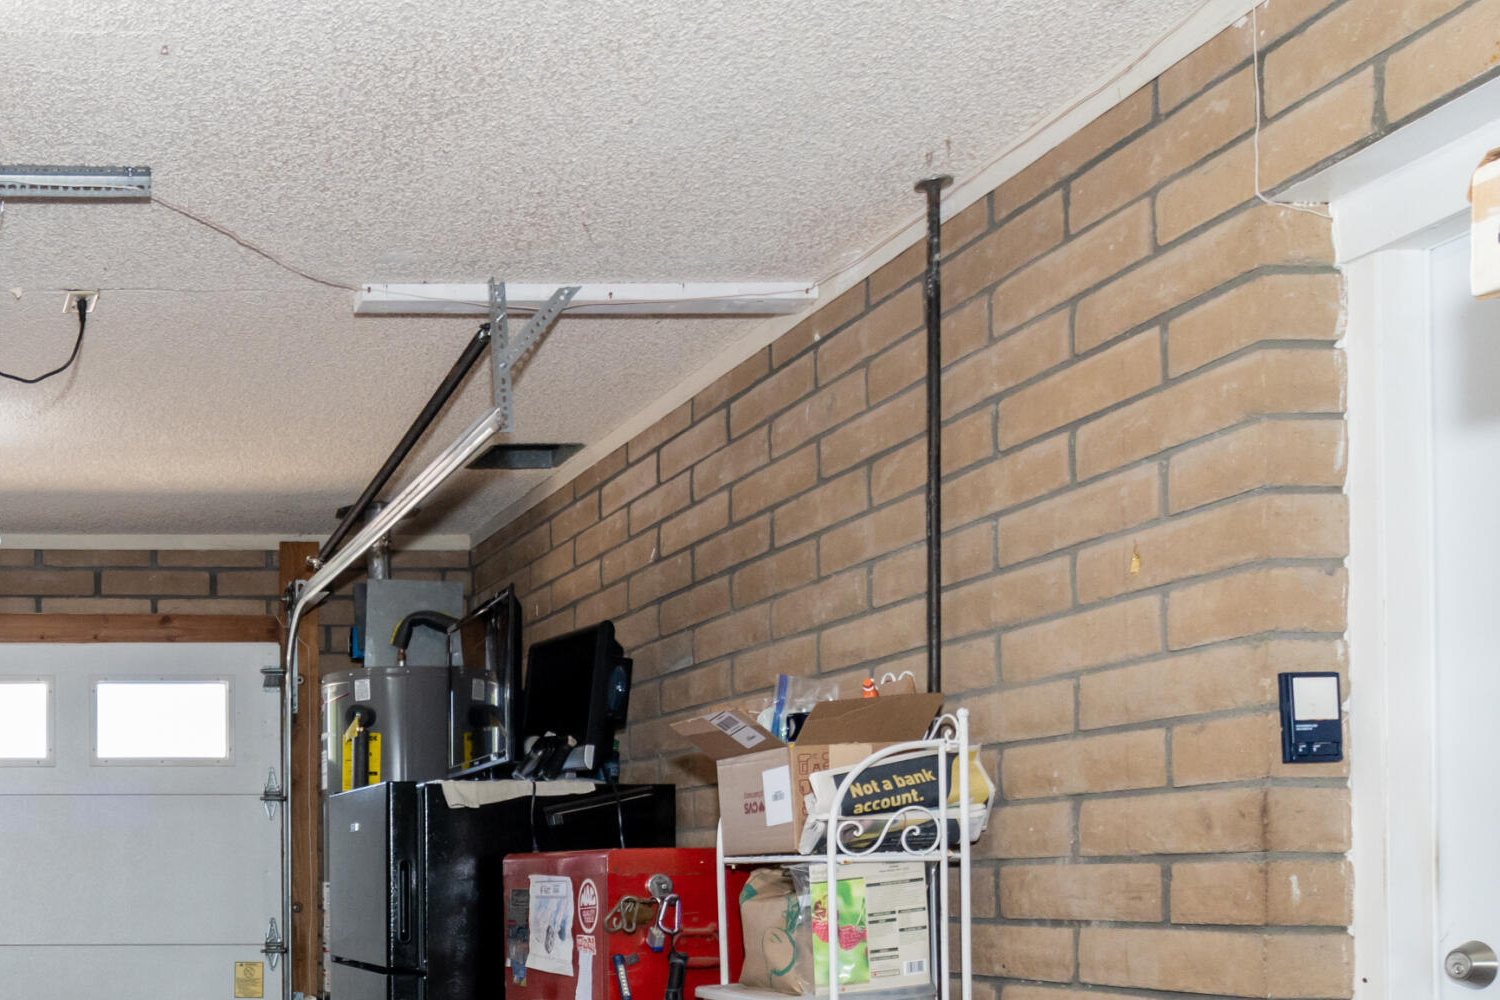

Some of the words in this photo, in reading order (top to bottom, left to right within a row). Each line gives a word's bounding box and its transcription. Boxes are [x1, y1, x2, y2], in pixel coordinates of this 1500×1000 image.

[849, 780, 880, 798] Not
[882, 779, 893, 790] a
[892, 768, 937, 788] bank
[853, 789, 924, 814] account.
